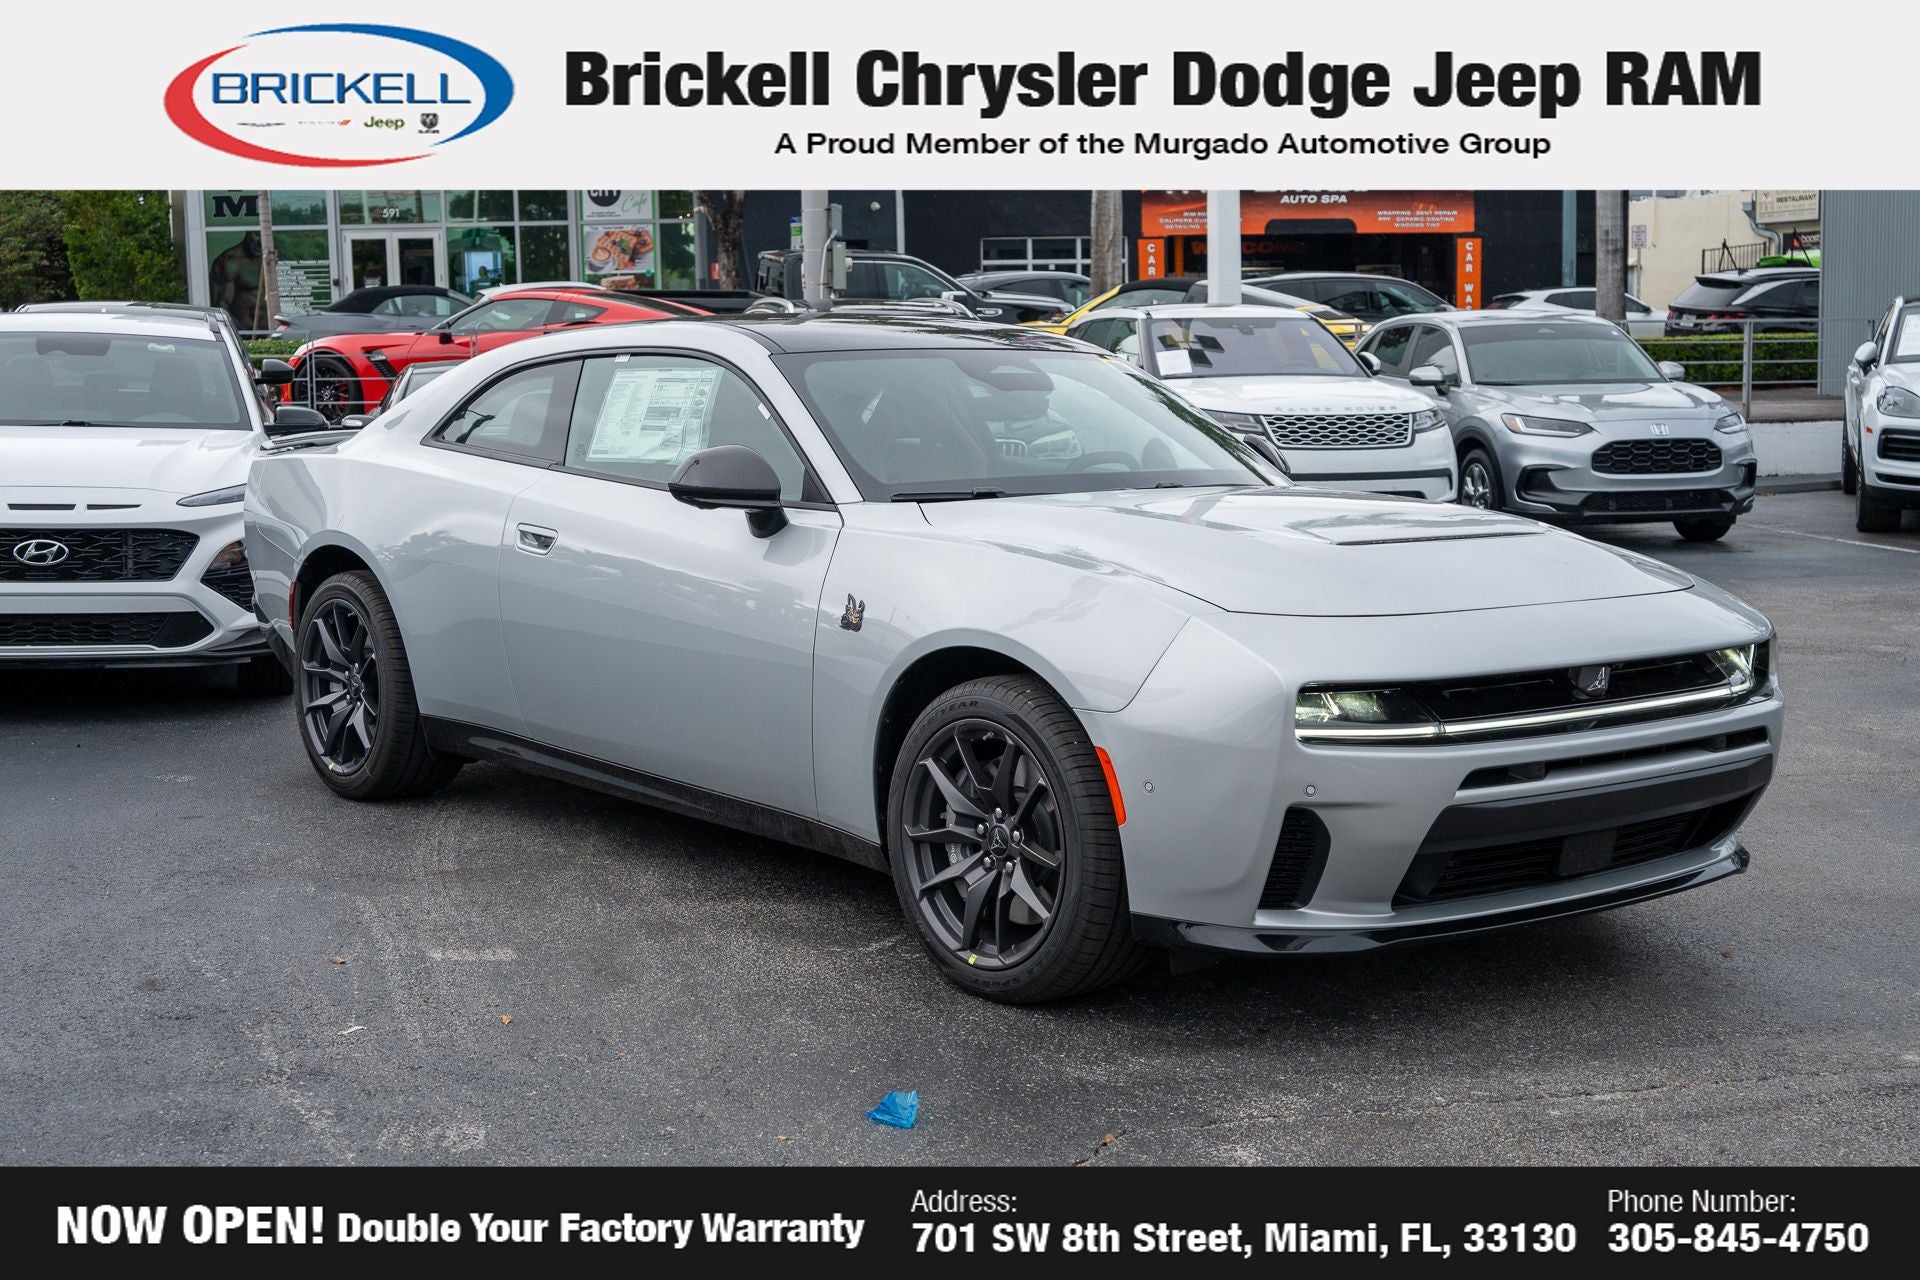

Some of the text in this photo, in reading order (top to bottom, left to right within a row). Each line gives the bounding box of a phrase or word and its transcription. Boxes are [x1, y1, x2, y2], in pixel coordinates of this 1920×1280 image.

[1280, 193, 1348, 204] AUTO SPA
[382, 208, 400, 218] 591
[1377, 209, 1412, 217] WRAPPING
[1147, 243, 1157, 277] CAR
